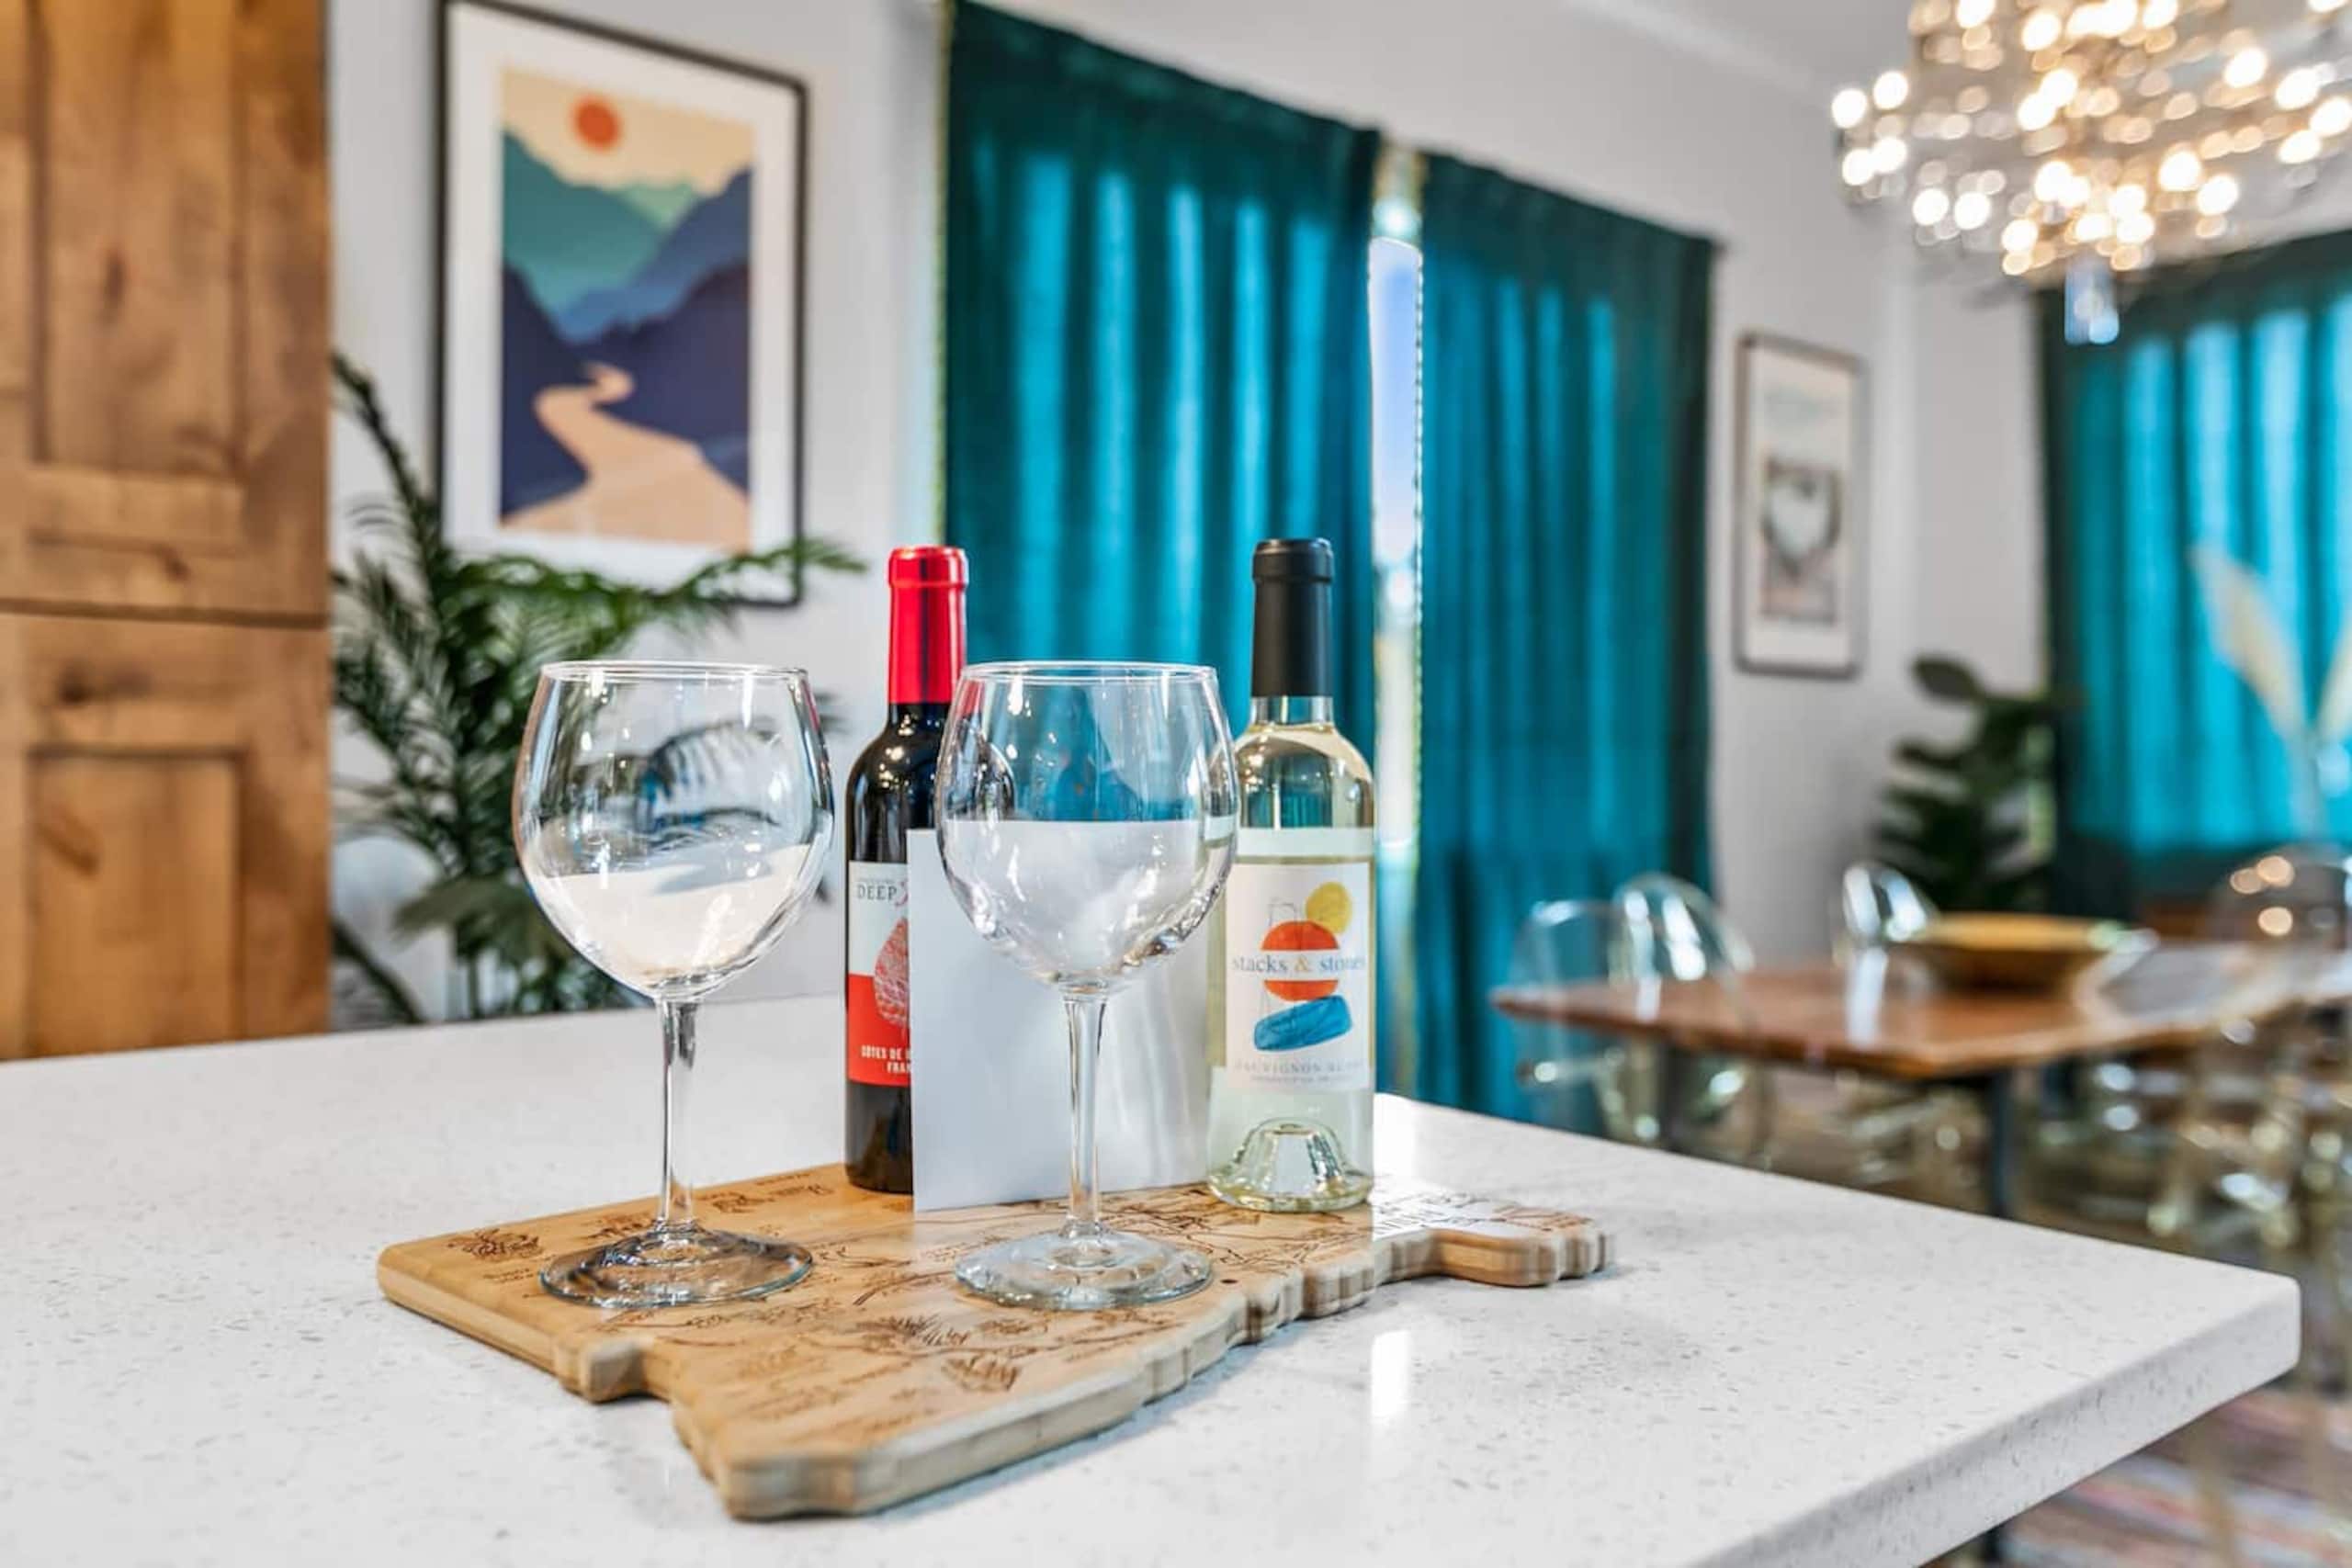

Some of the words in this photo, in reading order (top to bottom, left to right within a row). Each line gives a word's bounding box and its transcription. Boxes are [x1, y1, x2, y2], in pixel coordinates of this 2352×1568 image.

[856, 884, 898, 901] DEEP
[1231, 954, 1288, 974] stacks
[1294, 954, 1312, 974] &
[889, 1046, 902, 1061] DE
